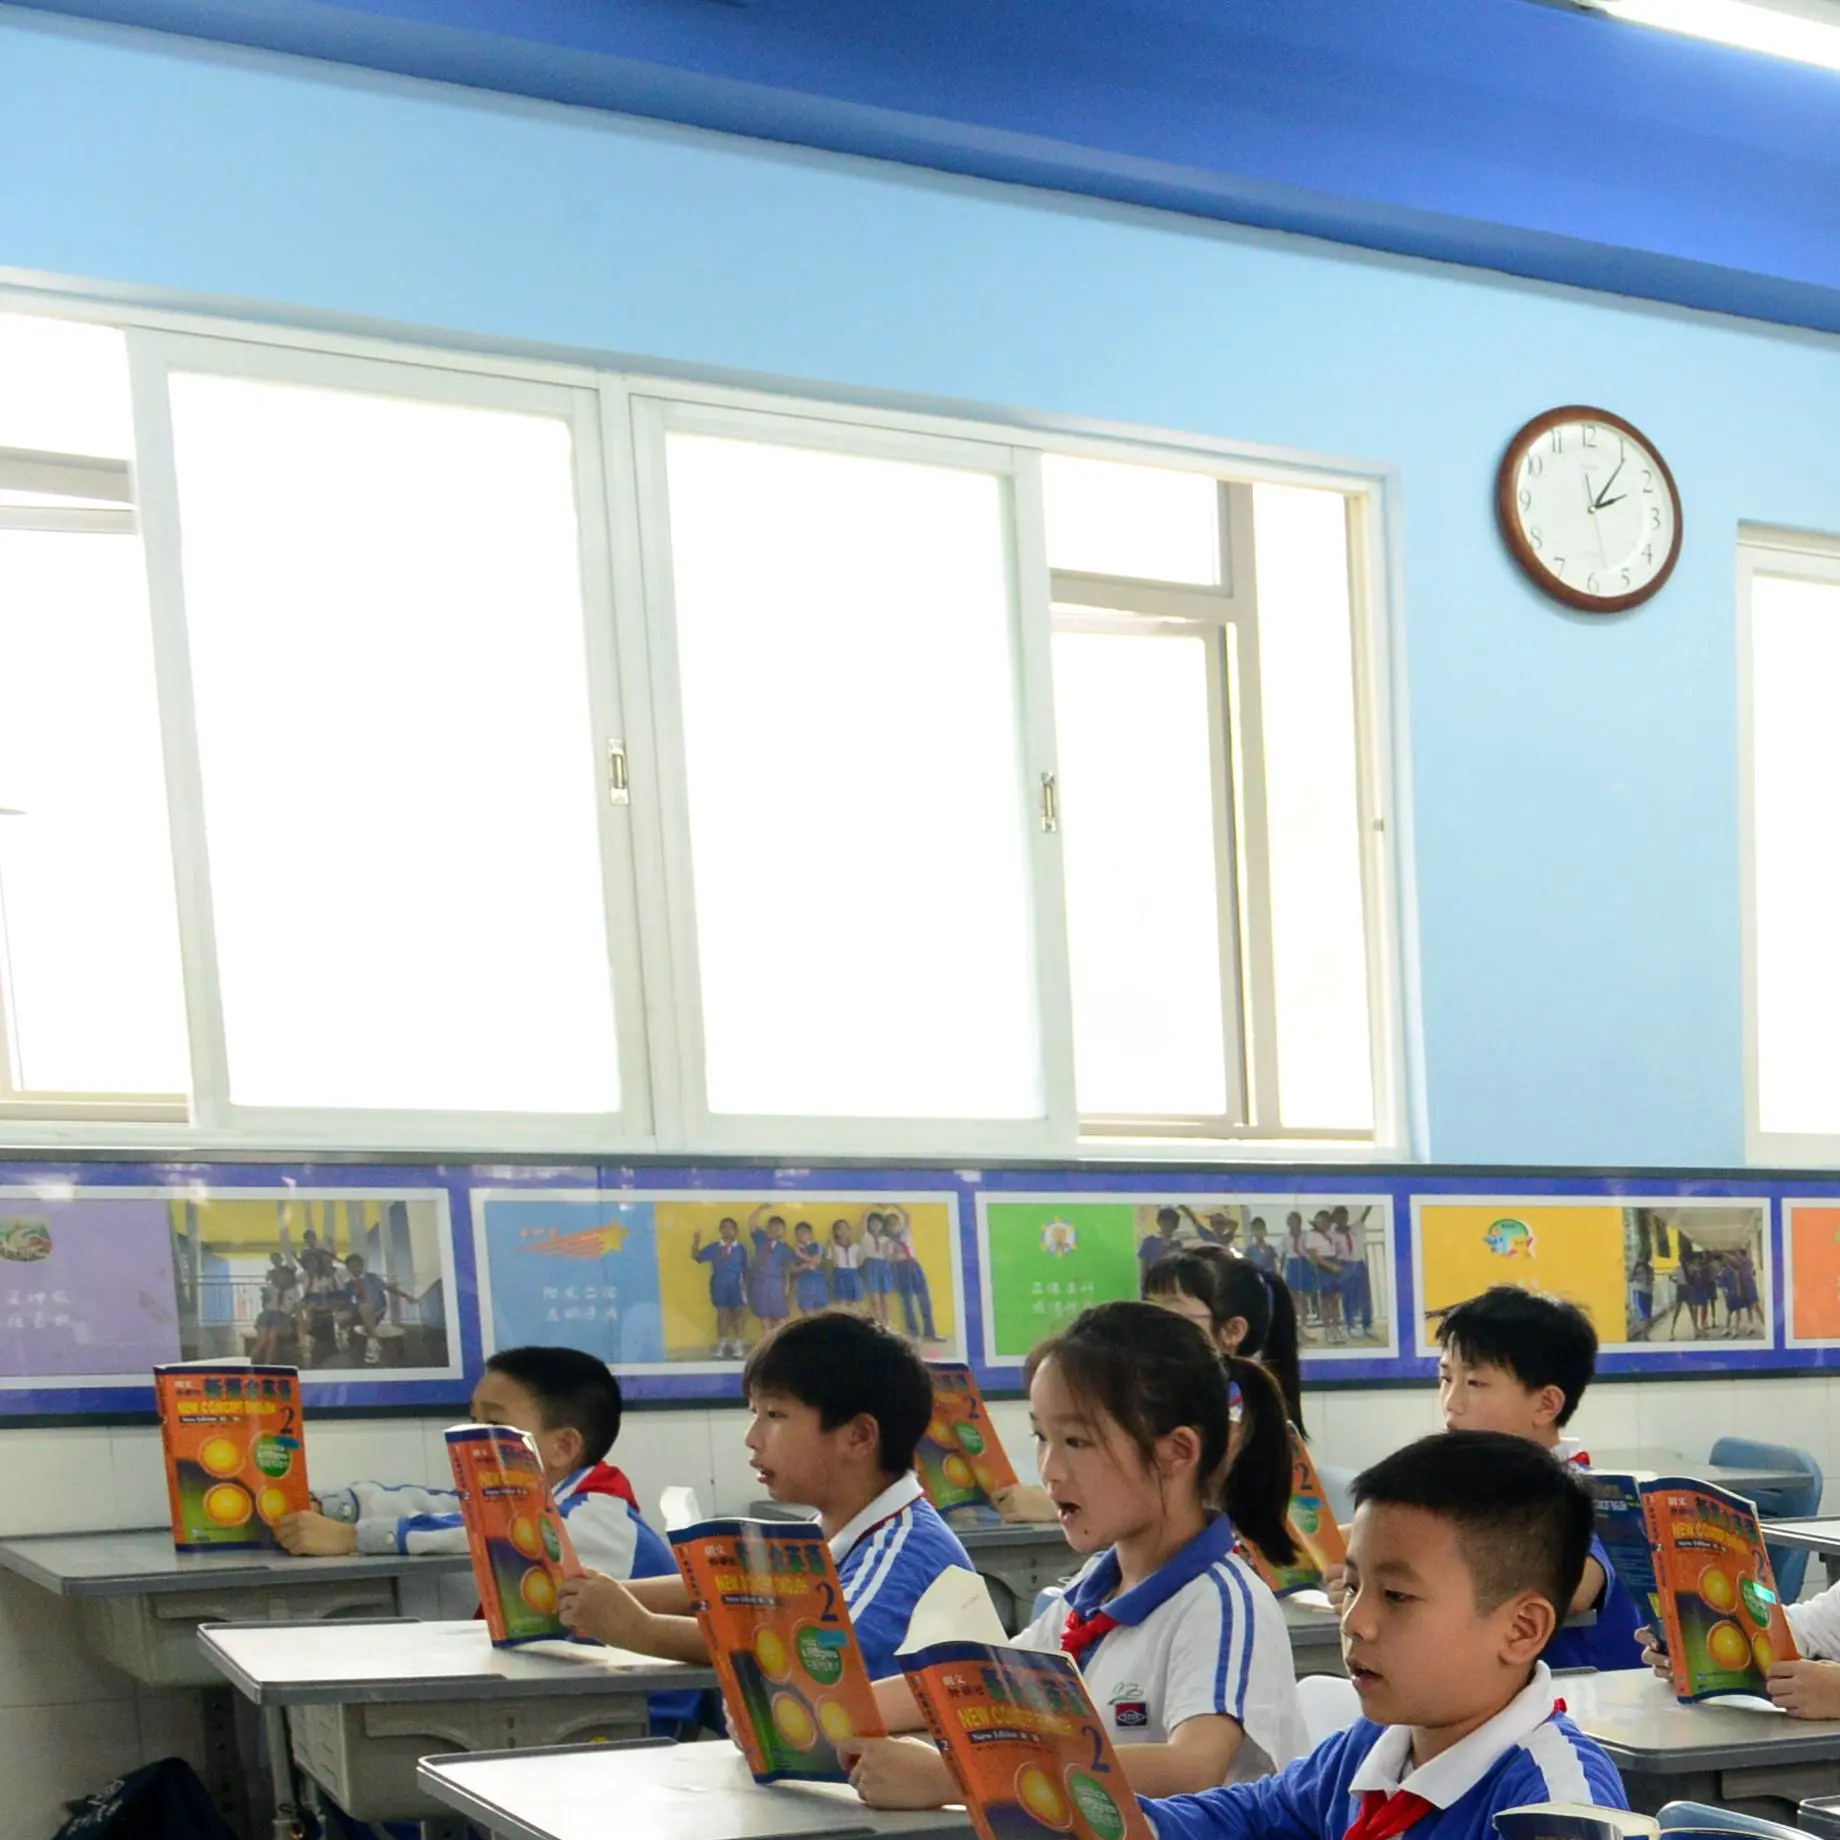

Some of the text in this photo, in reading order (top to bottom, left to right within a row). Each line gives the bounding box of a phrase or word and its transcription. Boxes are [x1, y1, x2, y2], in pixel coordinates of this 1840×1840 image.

[1552, 430, 1562, 453] 11
[1581, 425, 1597, 447] 12
[1528, 453, 1542, 476] 10
[1642, 470, 1652, 493] 2
[1519, 490, 1531, 512] 9
[1651, 507, 1661, 529] 3
[1530, 527, 1542, 550] 8
[1641, 544, 1652, 564] 4
[1554, 557, 1565, 577] 7
[1621, 568, 1630, 588] 5
[1587, 573, 1599, 593] 6
[968, 1397, 981, 1419] 2
[281, 1406, 295, 1434] 2
[1294, 1462, 1313, 1491] 2
[1672, 1523, 1692, 1535] NEW
[816, 1582, 839, 1621] 2
[957, 1708, 989, 1728] NEW
[1082, 1726, 1110, 1772] 2
